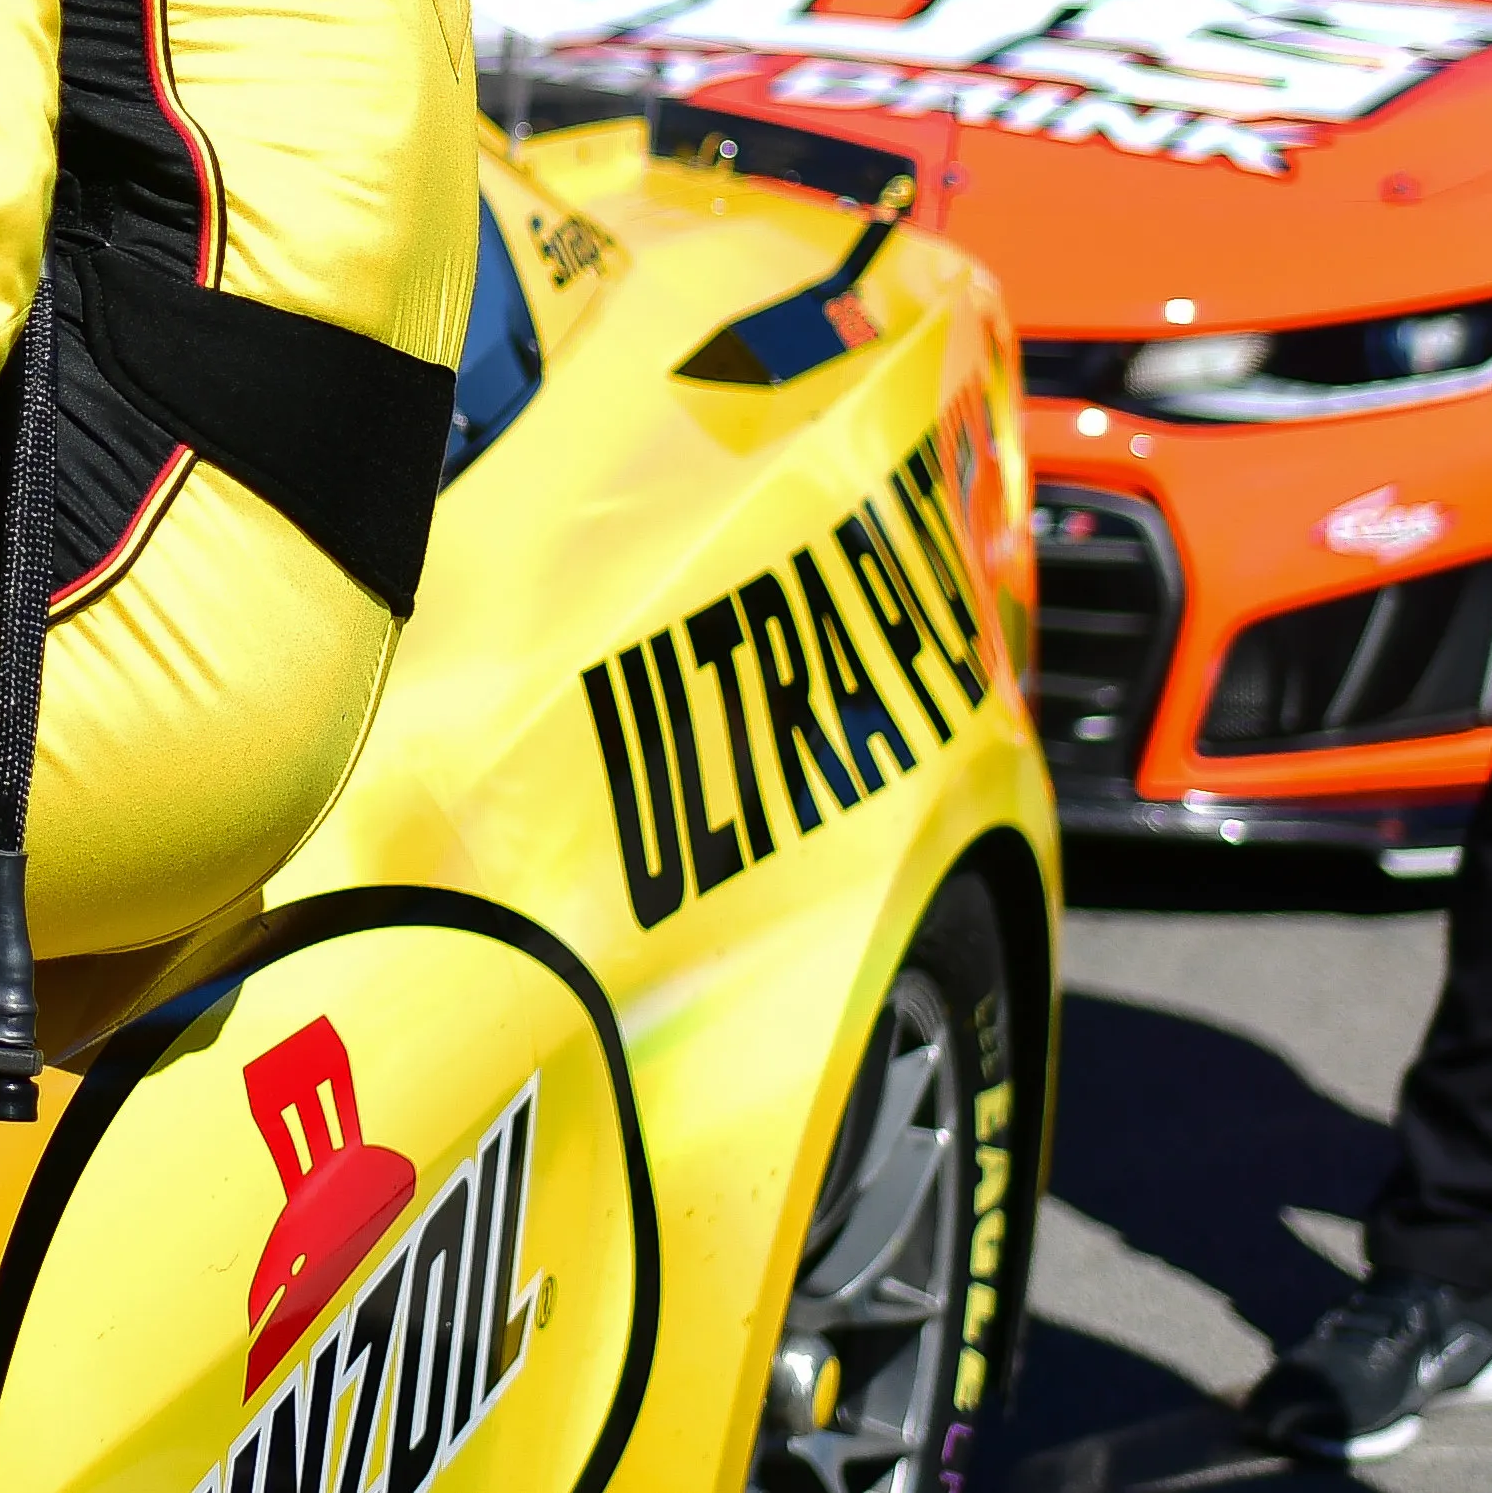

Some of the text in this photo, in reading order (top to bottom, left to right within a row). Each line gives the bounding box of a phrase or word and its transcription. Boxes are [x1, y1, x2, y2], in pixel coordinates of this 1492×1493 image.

[770, 53, 1293, 174] DRINK
[579, 544, 919, 932] ULTRA
[953, 1078, 1013, 1413] EAGLE
